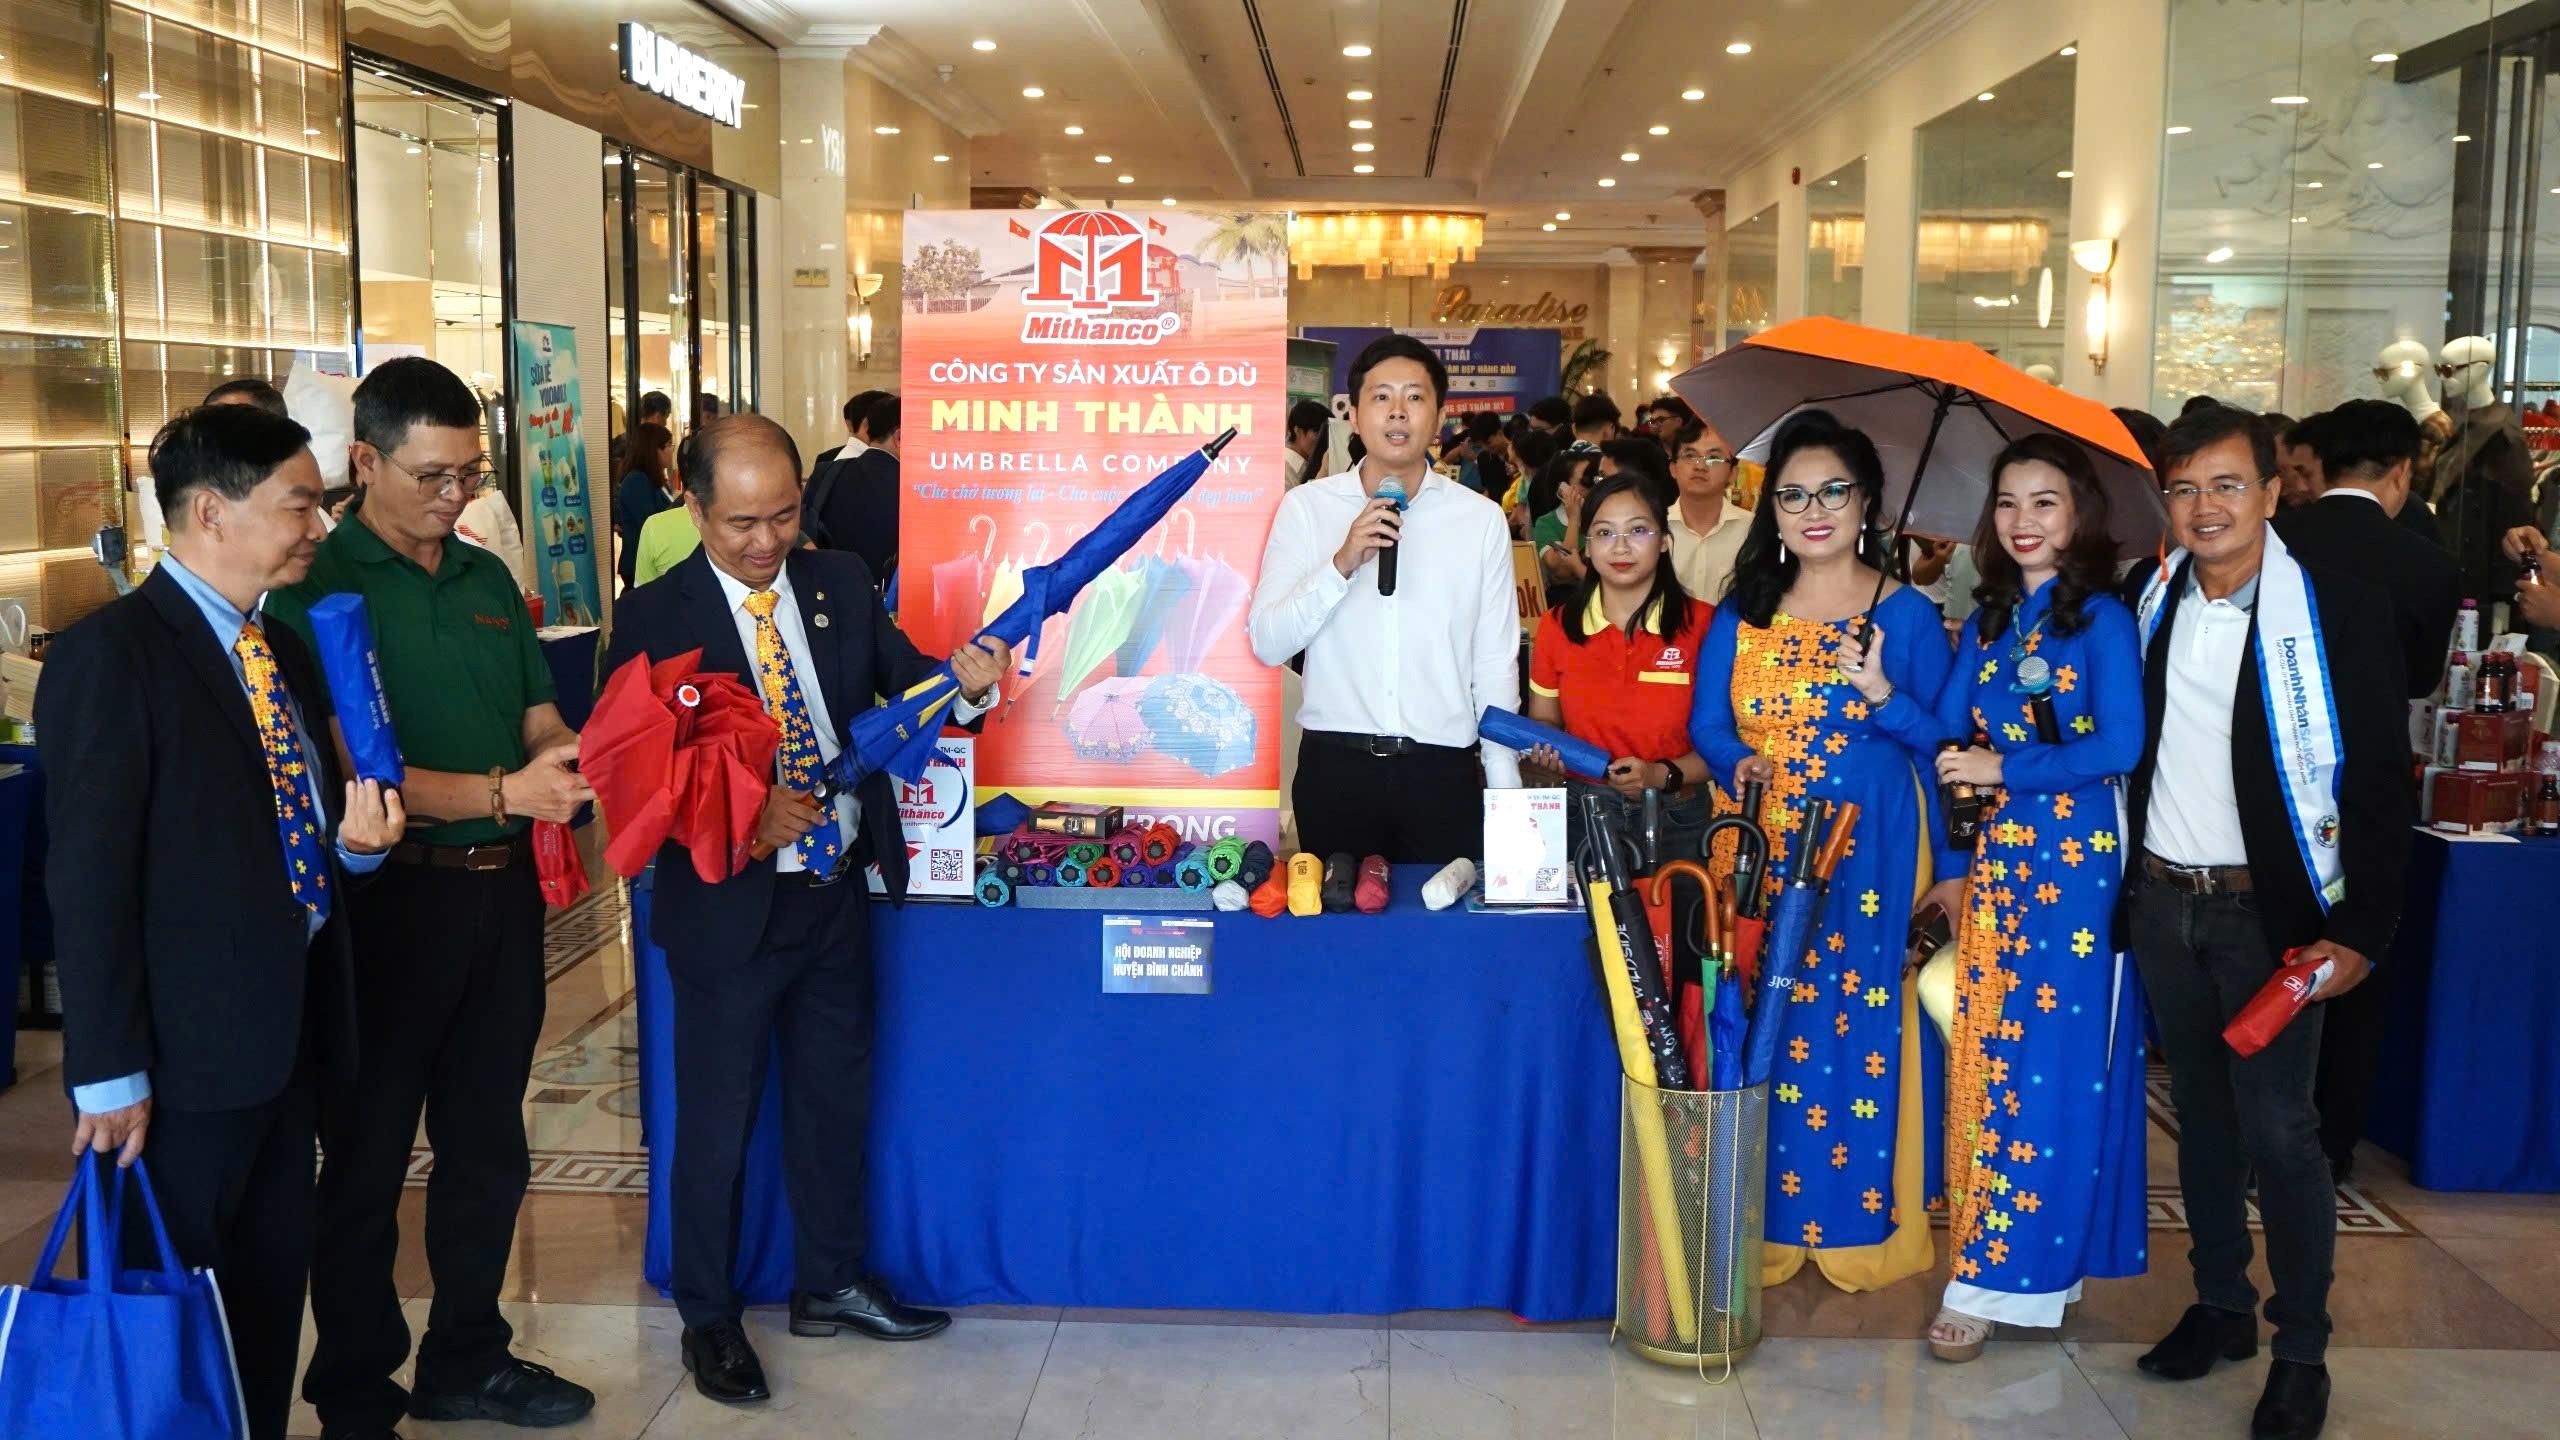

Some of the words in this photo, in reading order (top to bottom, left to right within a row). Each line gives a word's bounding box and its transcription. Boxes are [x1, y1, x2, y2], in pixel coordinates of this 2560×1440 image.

[629, 21, 746, 129] BURBERRY
[1430, 284, 1588, 323] Paradise
[1025, 317, 1158, 341] Mithanco
[929, 358, 1008, 384] CÔNG
[1014, 363, 1047, 384] TY
[1053, 358, 1106, 384] SẢN
[1113, 358, 1184, 385] XUẤT
[1189, 361, 1211, 386] Ô
[1218, 362, 1257, 386] DÙ
[931, 400, 1058, 432] MINH
[1075, 393, 1252, 434] THÀNH
[930, 452, 1089, 472] UMBRELLA
[1102, 454, 1251, 474] COMNY
[898, 808, 945, 819] ithanco
[1114, 943, 1131, 960] HỘI
[1133, 945, 1166, 958] DOANH
[1167, 944, 1202, 961] NGHIỆP
[1113, 961, 1144, 978] HUYỆN
[1146, 961, 1169, 976] BÌNH
[1171, 962, 1203, 977] CHÁNH
